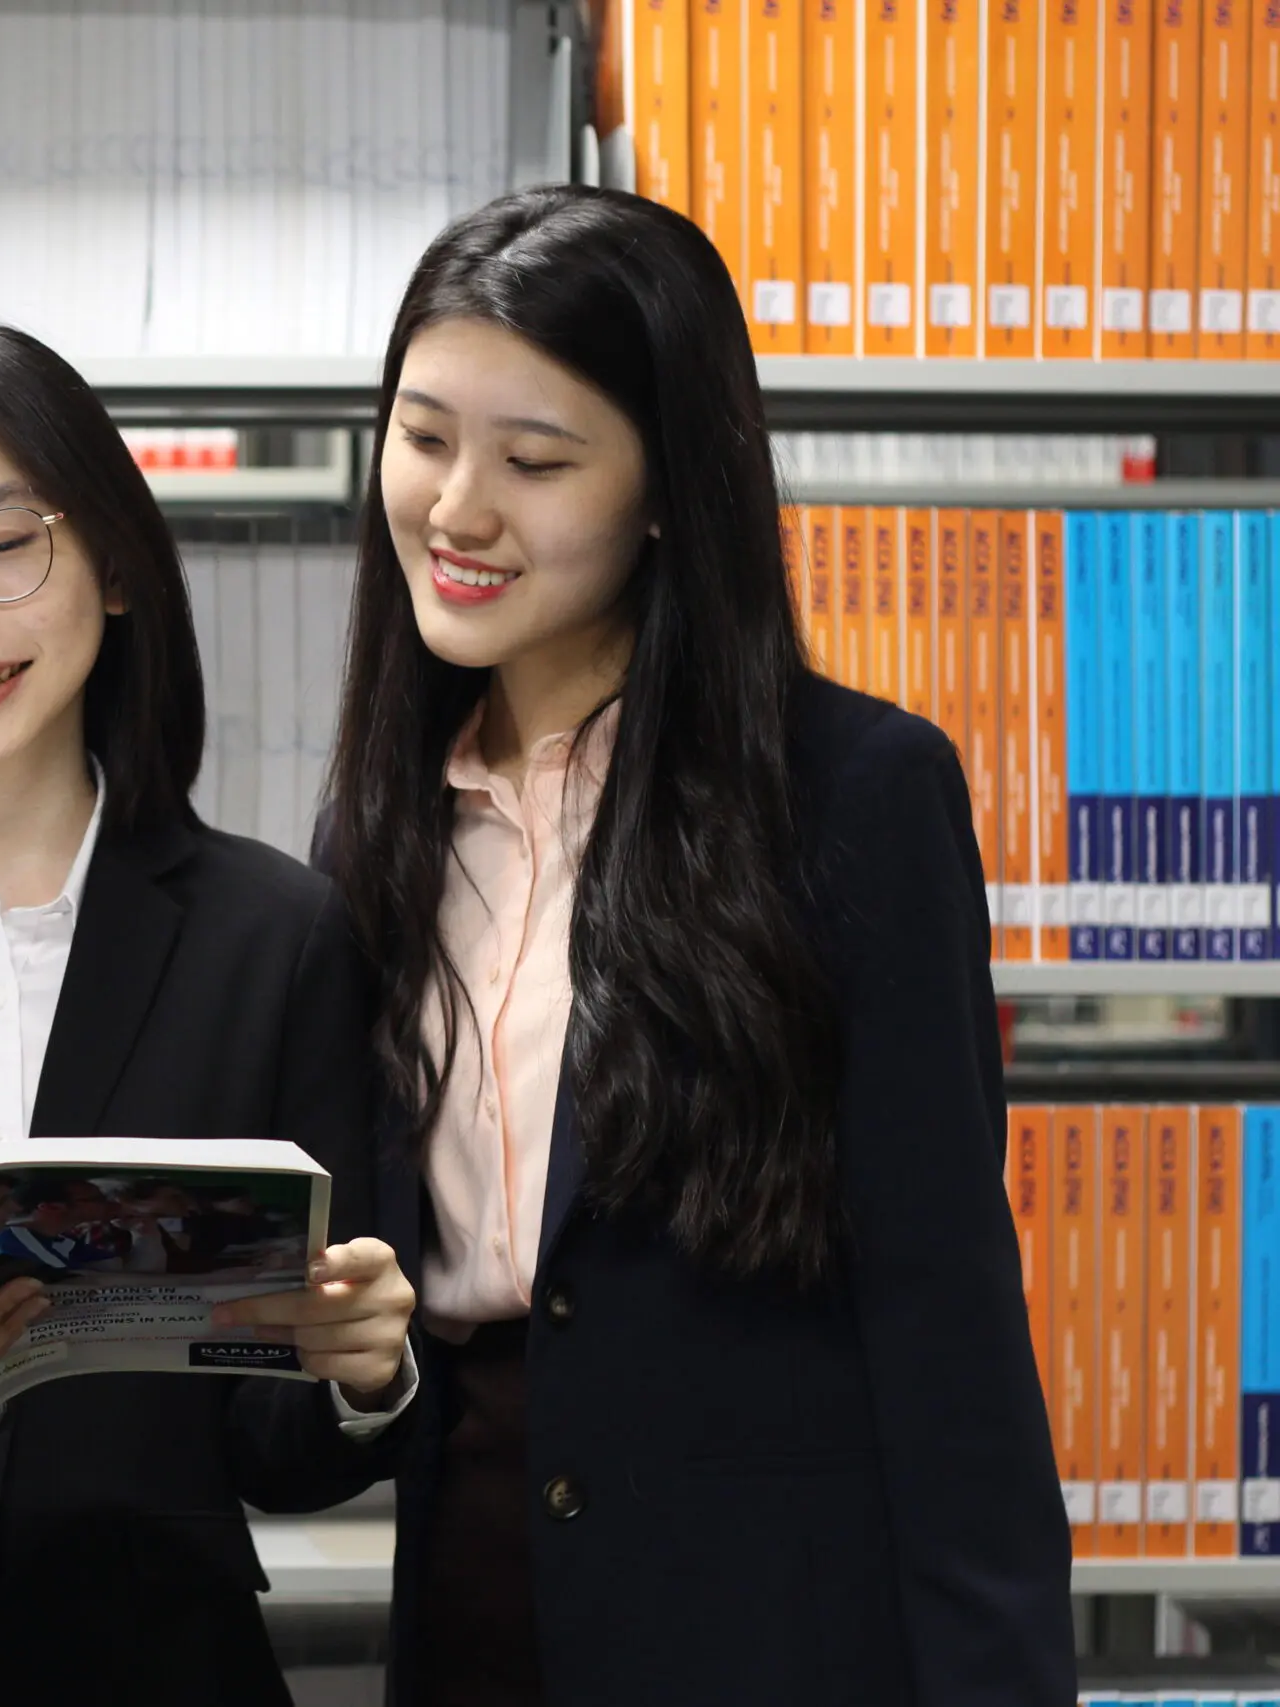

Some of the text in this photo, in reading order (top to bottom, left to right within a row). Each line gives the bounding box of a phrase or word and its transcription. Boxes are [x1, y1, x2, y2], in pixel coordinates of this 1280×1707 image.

[158, 1286, 177, 1295] IN
[29, 1316, 136, 1335] FOUNDATIONS
[139, 1316, 155, 1324] IN
[158, 1315, 207, 1323] TAXAT
[200, 1347, 280, 1356] KAPLAN
